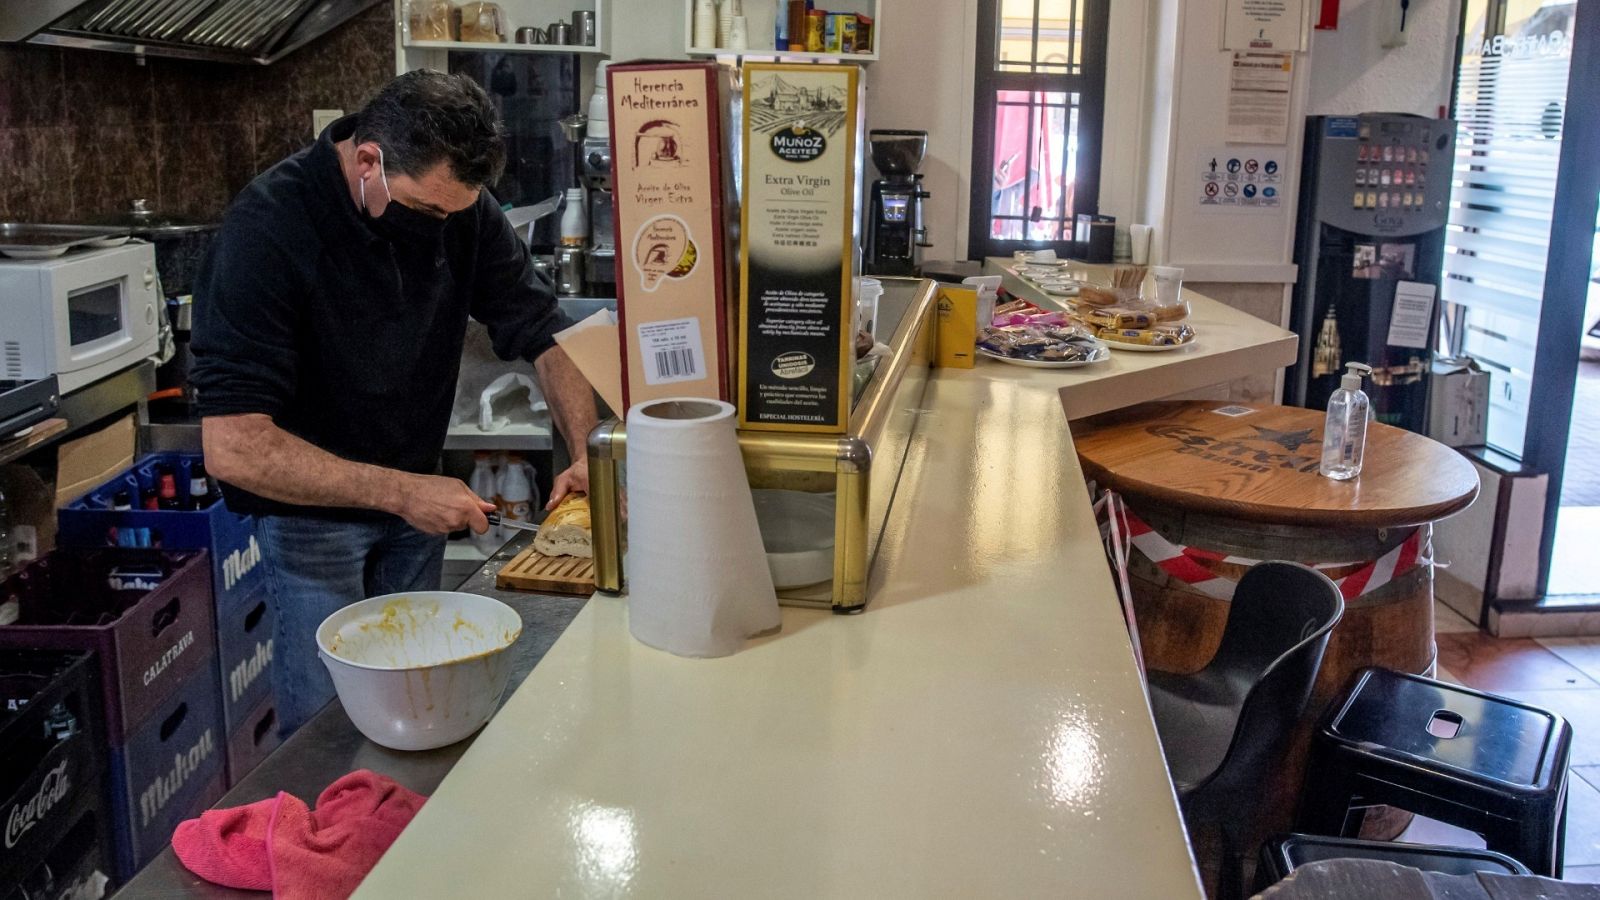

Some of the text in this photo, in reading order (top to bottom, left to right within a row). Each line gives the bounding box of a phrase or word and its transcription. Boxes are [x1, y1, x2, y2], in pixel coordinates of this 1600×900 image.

[634, 77, 684, 92] Herencia
[621, 94, 699, 110] Mediterránea
[773, 136, 822, 148] MUÑOZ
[779, 147, 818, 155] ACEITES
[663, 183, 672, 191] de
[765, 174, 831, 188] Extra Virgin
[780, 187, 814, 196] Olive Oil
[635, 192, 693, 208] Virgen Extra
[222, 534, 260, 590] Mah
[143, 630, 195, 687] CALATRAVA
[230, 638, 273, 703] Maho
[139, 727, 213, 828] Mahou
